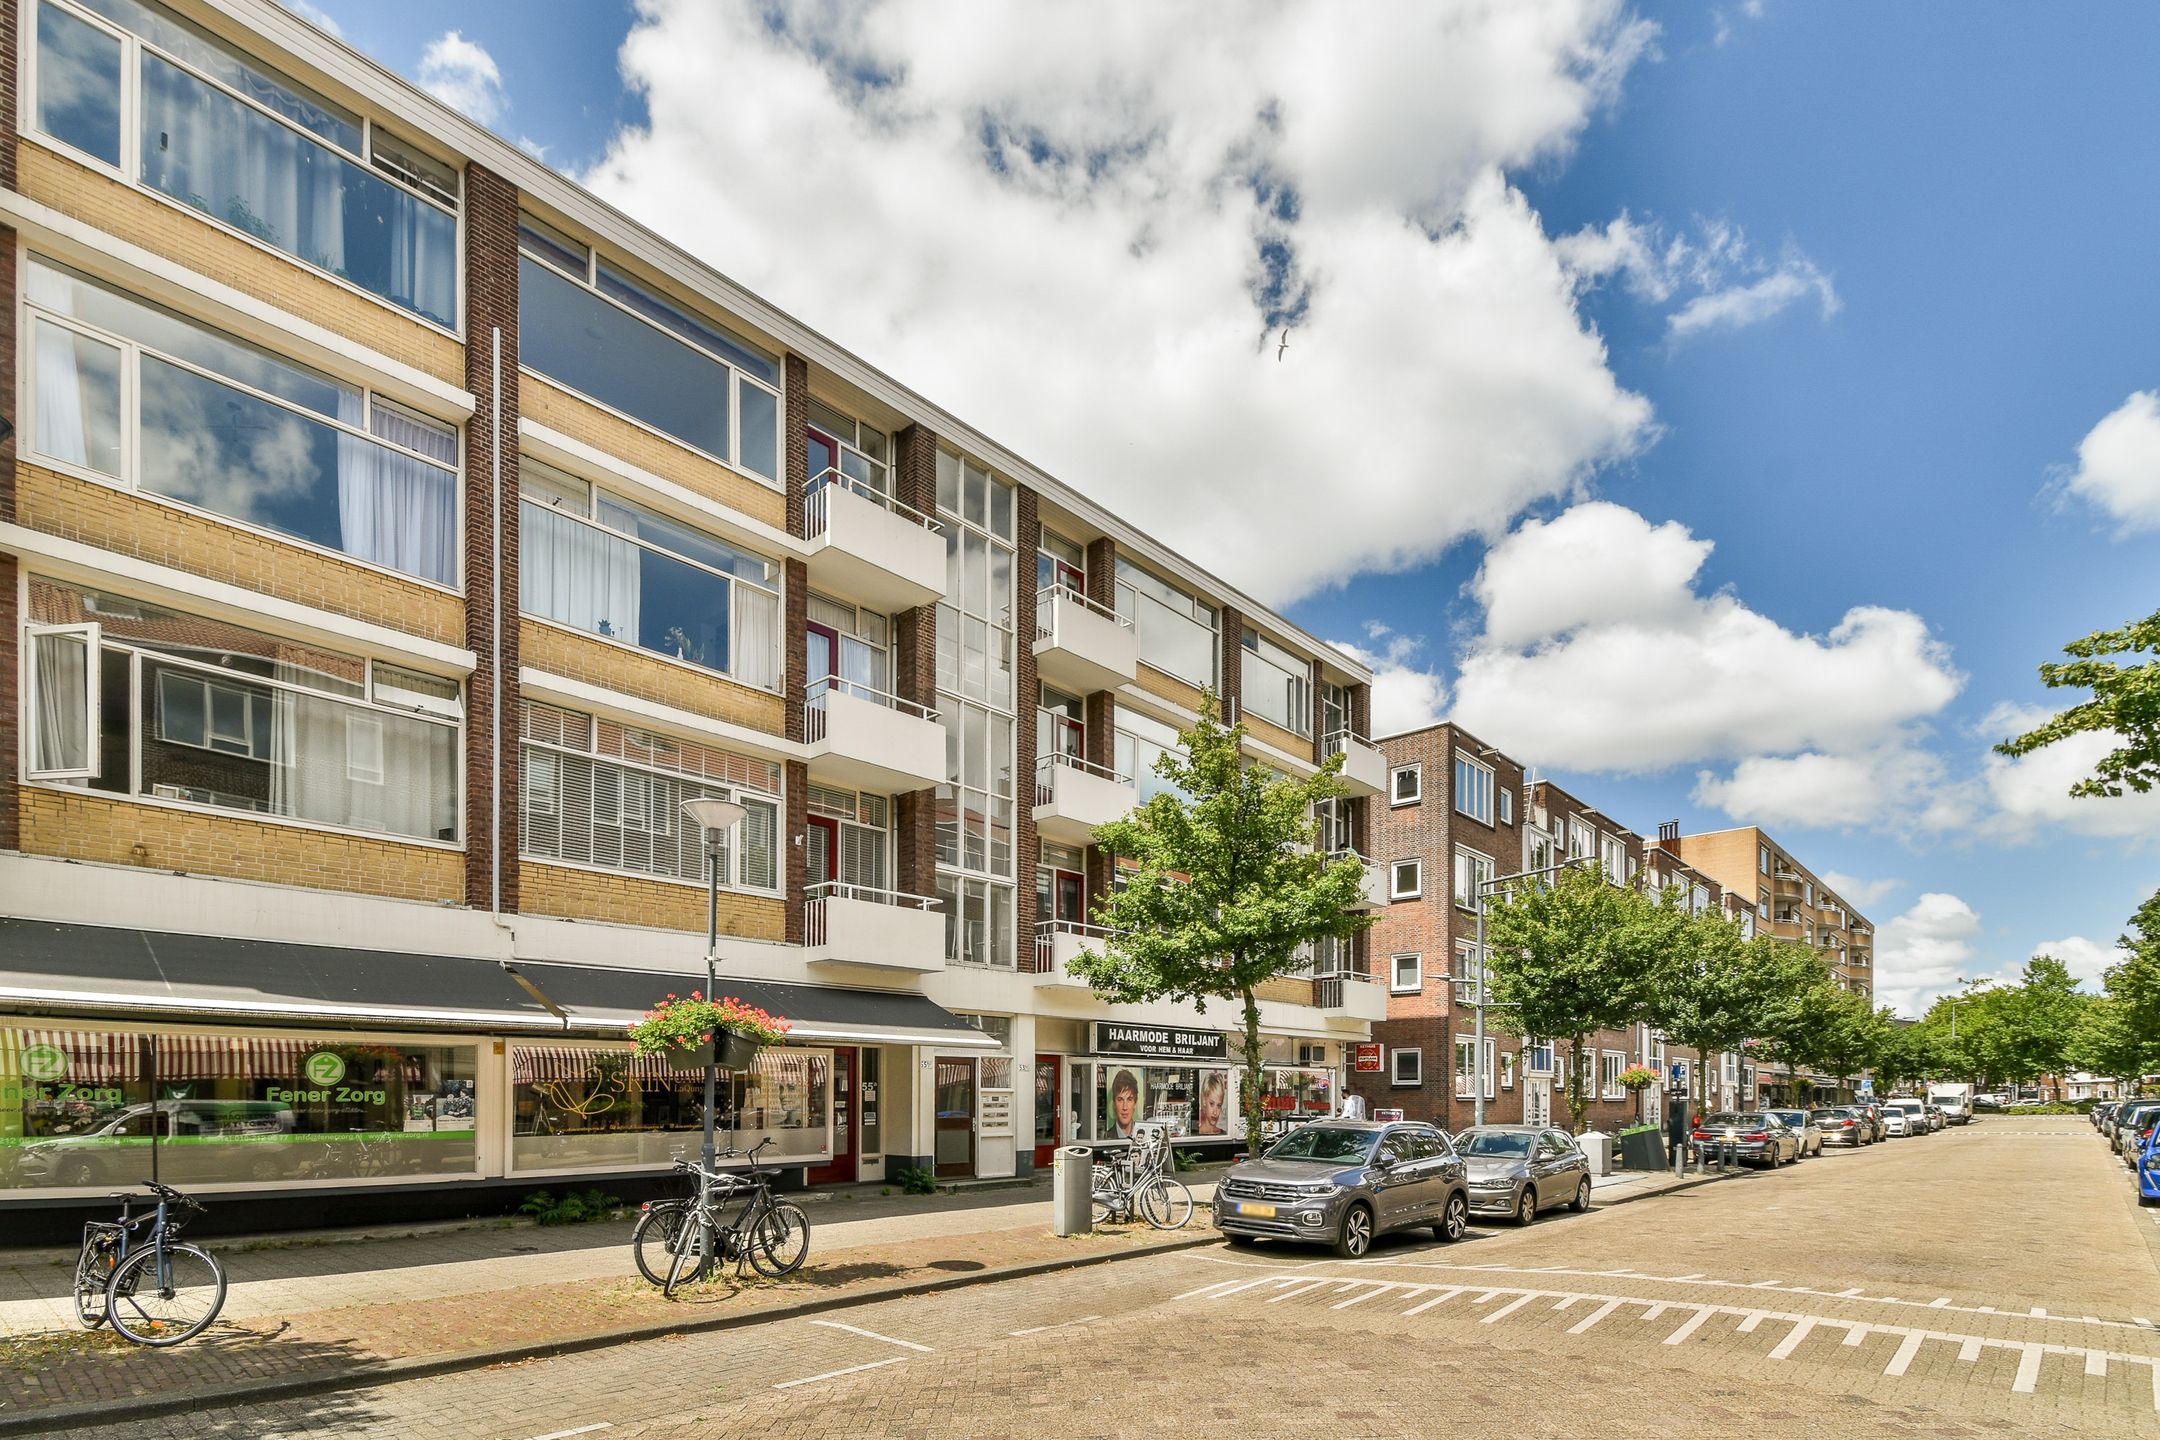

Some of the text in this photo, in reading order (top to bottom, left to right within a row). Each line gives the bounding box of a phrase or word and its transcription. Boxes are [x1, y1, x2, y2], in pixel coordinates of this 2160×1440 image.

[1109, 1028, 1220, 1047] HAARMODE BRILJANT
[1140, 1045, 1156, 1053] VOOR
[1158, 1046, 1171, 1054] HEM
[1177, 1047, 1194, 1055] HAAR
[610, 1071, 672, 1093] SKIN
[4, 1083, 122, 1105] ner Zorg
[266, 1086, 385, 1105] Fener Zorg
